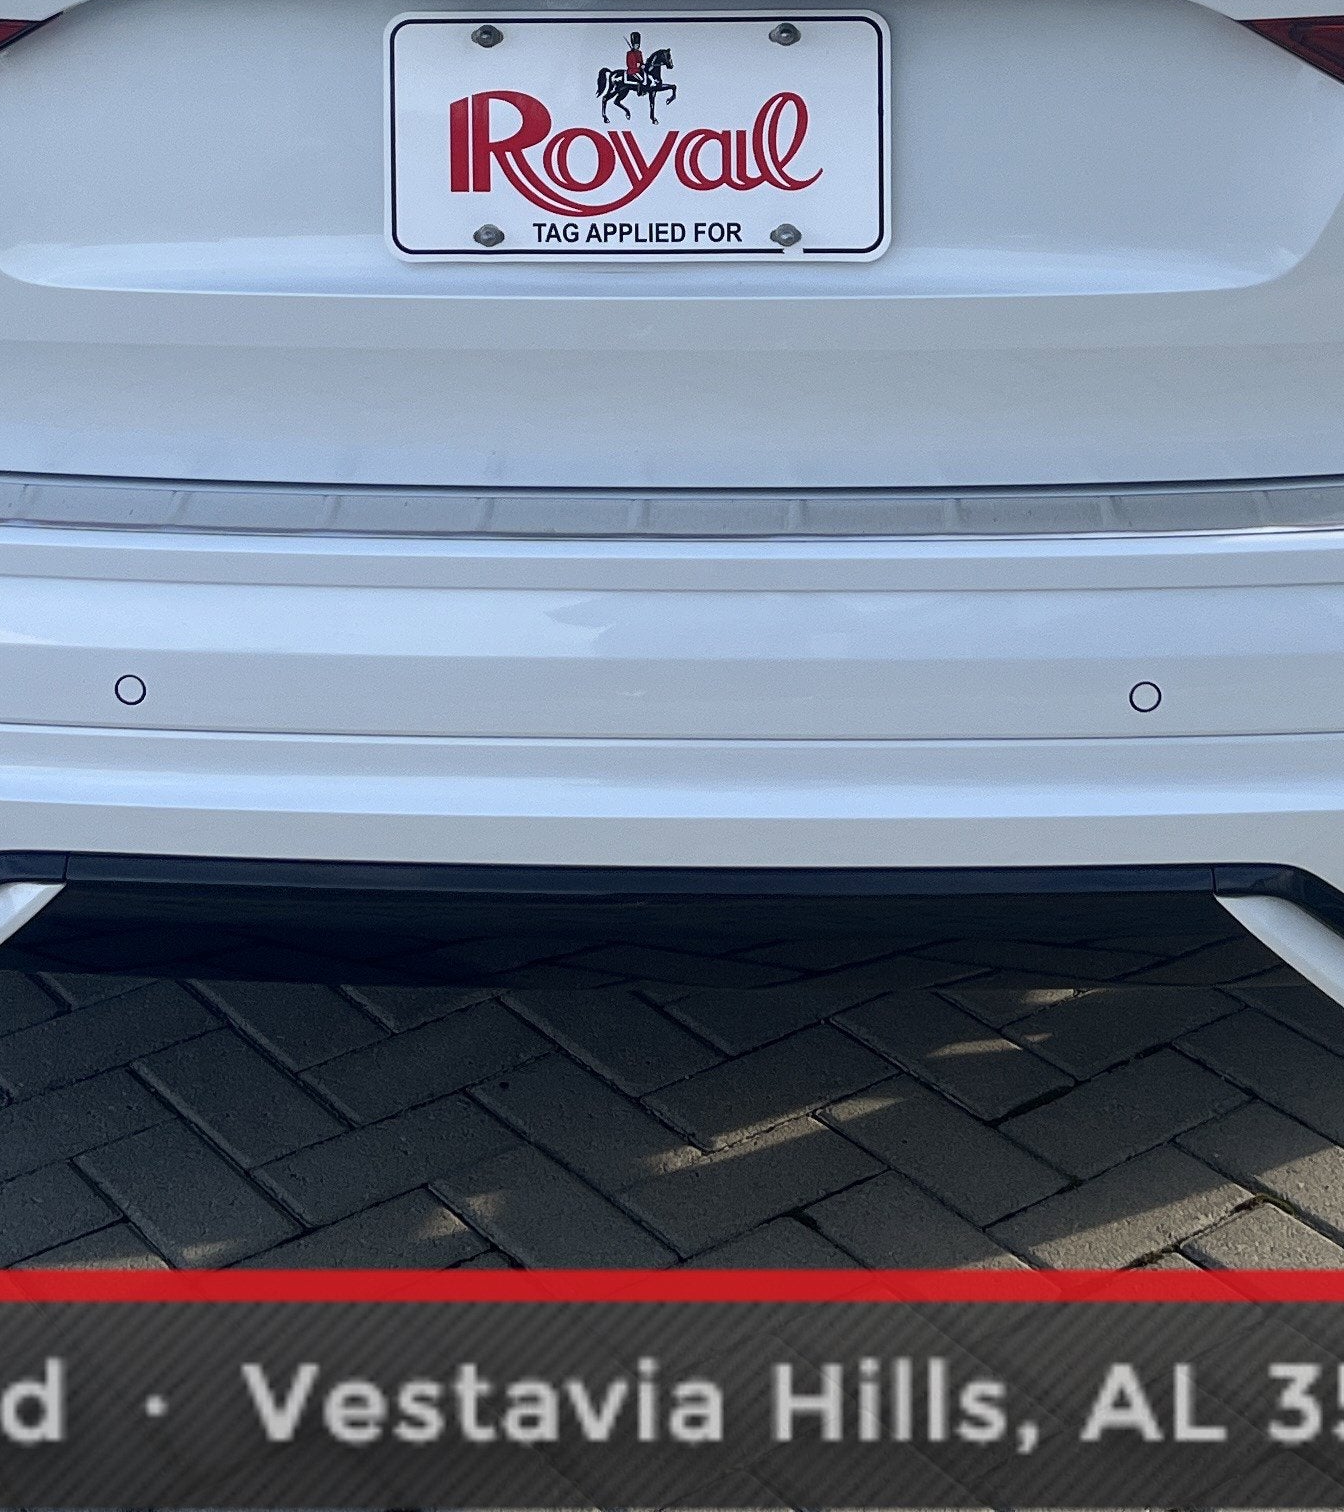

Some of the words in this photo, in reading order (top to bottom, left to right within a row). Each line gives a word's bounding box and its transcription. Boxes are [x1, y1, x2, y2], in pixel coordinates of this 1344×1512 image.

[449, 90, 824, 218] Royal
[532, 222, 579, 243] TAG
[585, 222, 686, 243] APPLIED
[694, 222, 743, 243] FOR
